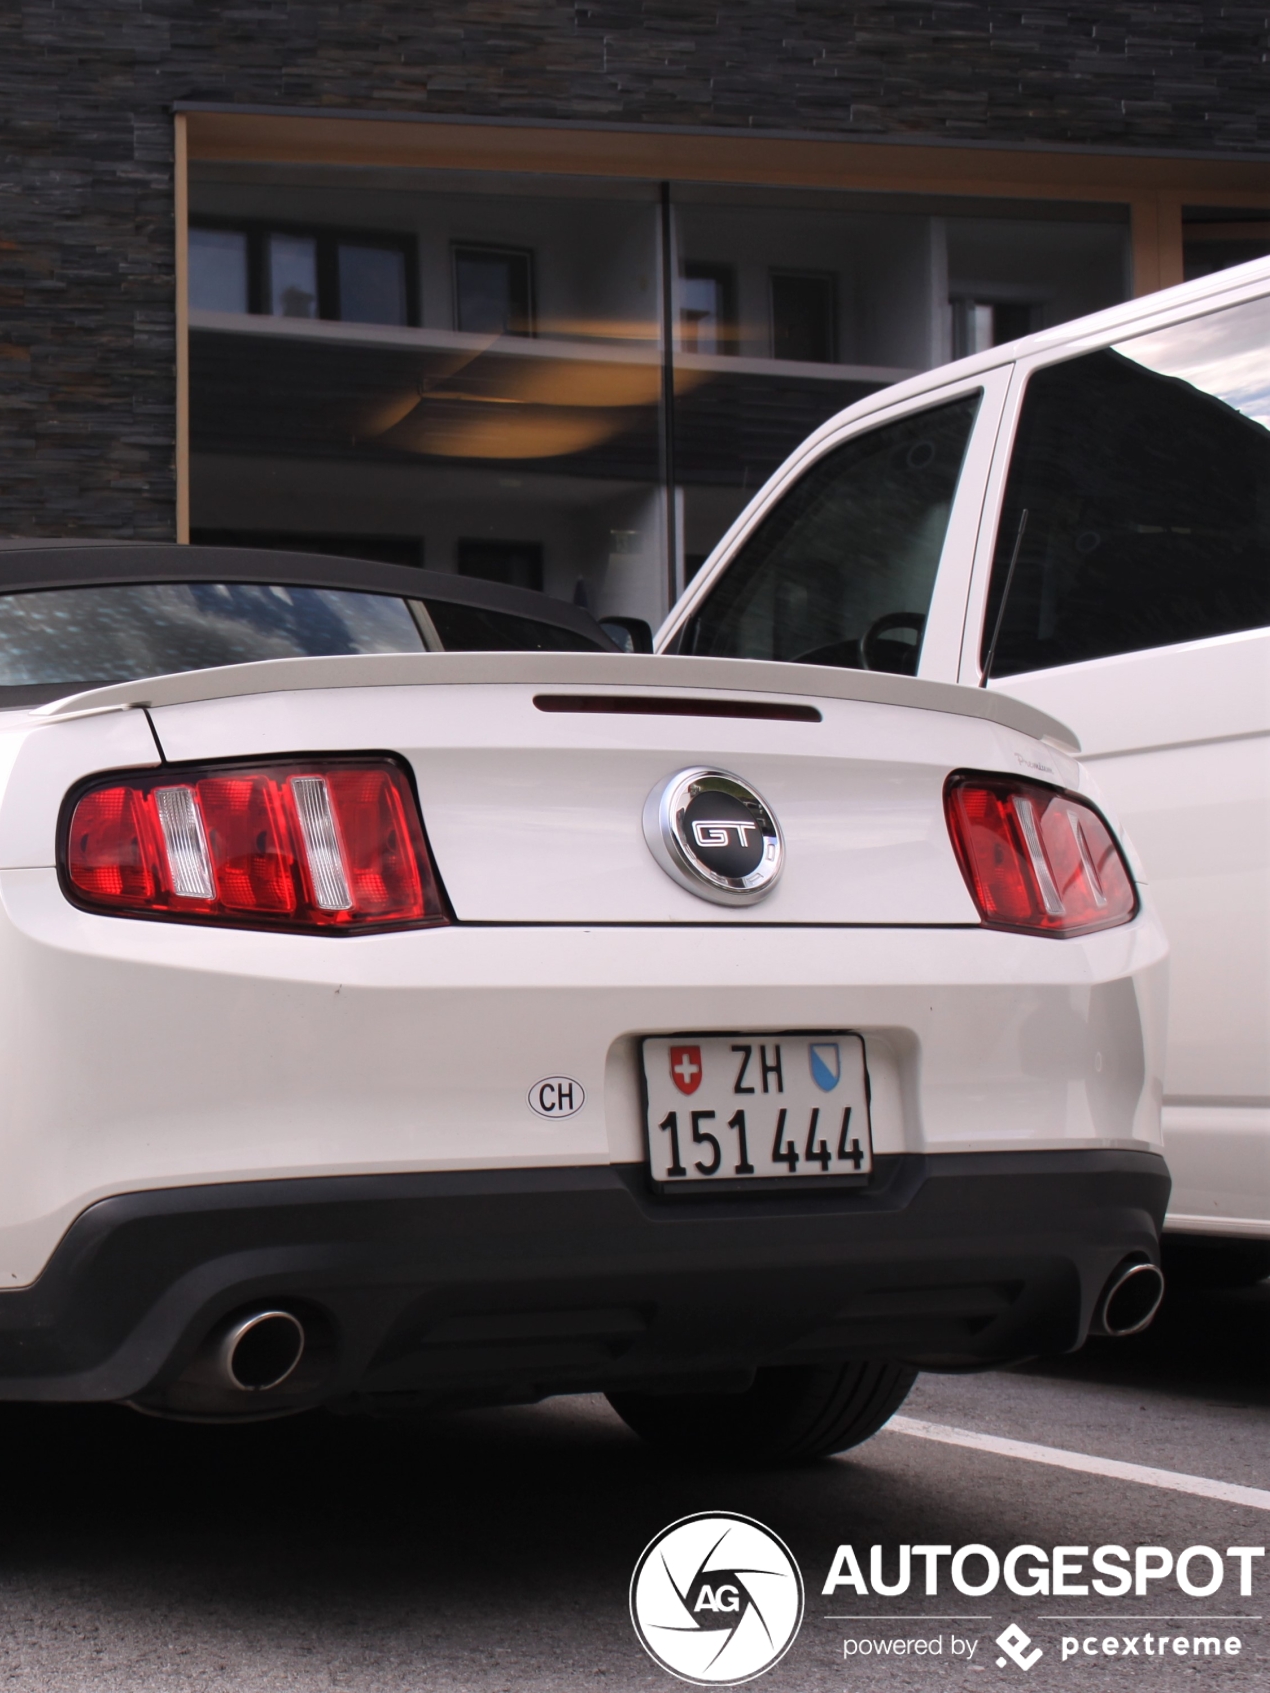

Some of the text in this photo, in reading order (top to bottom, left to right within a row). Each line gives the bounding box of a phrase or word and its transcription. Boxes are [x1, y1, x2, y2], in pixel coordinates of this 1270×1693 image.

[692, 820, 755, 848] GT
[731, 1044, 783, 1095] ZH
[539, 1082, 575, 1112] CH
[658, 1106, 865, 1177] 151 444
